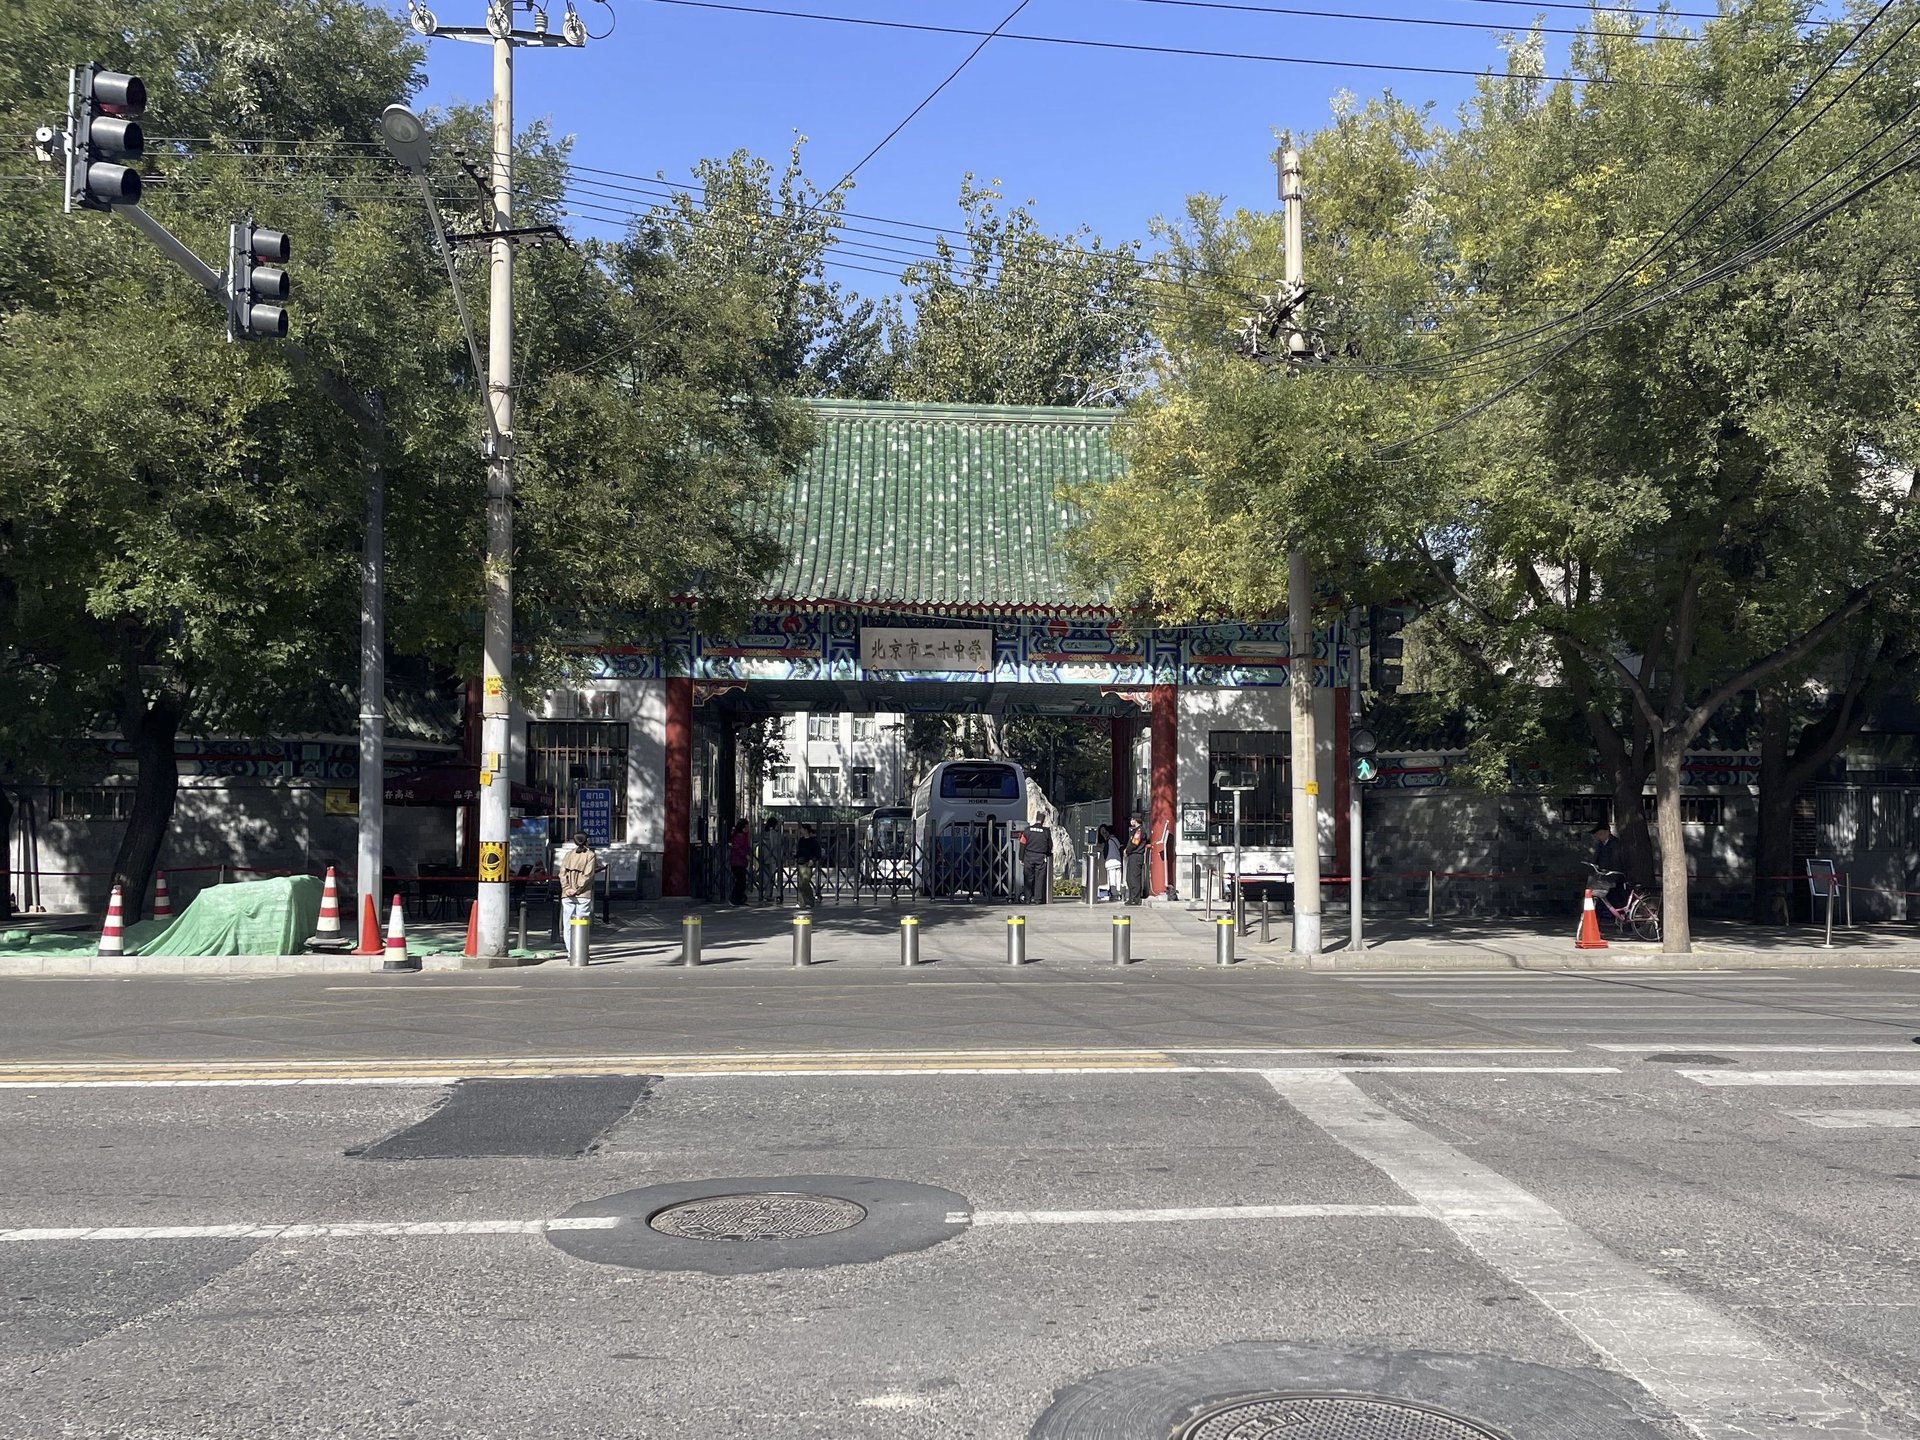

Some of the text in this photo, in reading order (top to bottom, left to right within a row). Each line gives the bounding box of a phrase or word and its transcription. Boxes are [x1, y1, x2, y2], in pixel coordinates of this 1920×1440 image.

[872, 638, 981, 662] 北京市二十中学
